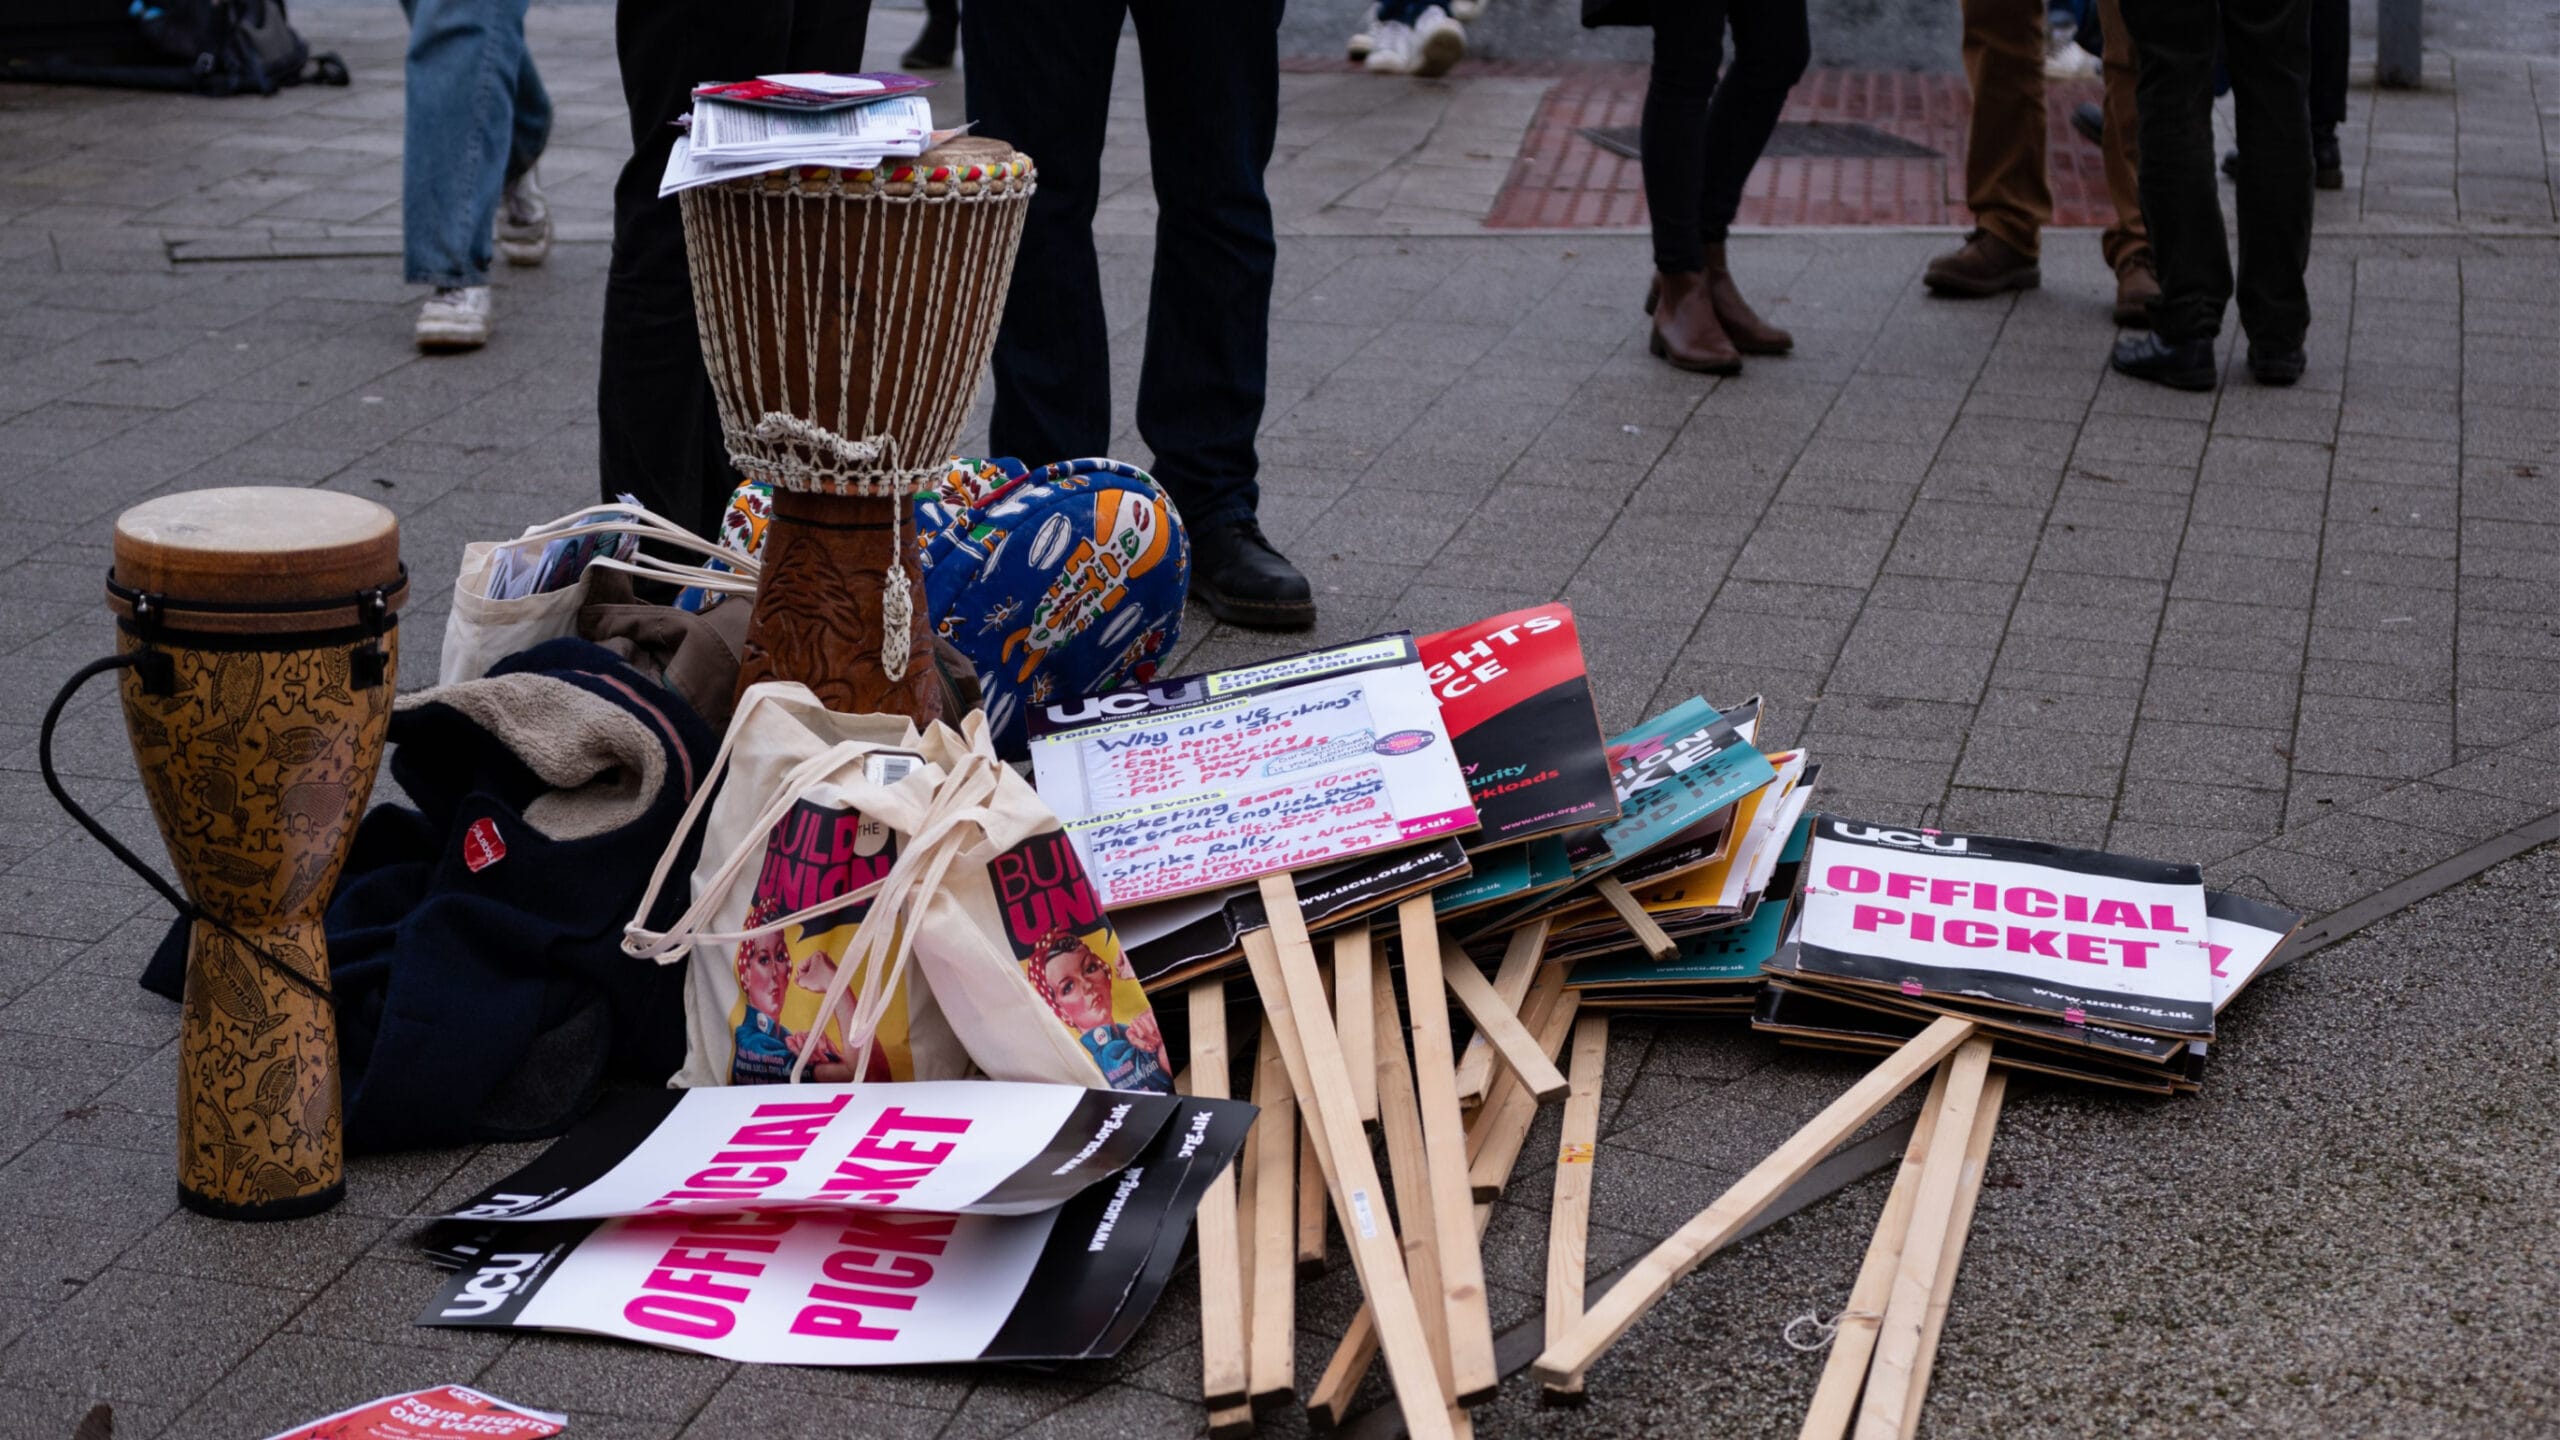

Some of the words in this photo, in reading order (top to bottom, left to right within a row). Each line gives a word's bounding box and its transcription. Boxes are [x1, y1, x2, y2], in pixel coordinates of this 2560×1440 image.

[1217, 661, 1299, 682] Trevor
[1308, 652, 1348, 664] the
[1426, 616, 1562, 685] GHTS
[1218, 651, 1395, 691] Strikeosaurus
[1442, 658, 1508, 698] CE
[1054, 722, 1129, 742] Today's
[1137, 698, 1247, 725] Campaigns
[1101, 711, 1148, 723] University
[1150, 706, 1167, 715] and
[1169, 700, 1204, 711] College
[1206, 694, 1233, 703] Union
[1097, 731, 1168, 752] Why
[1179, 719, 1225, 737] are
[1124, 741, 1241, 769] Equality
[1125, 745, 1173, 759] Fair
[1182, 720, 1293, 750] Pensions
[1127, 764, 1175, 778] Job
[1130, 770, 1182, 787] Fair
[1200, 736, 1329, 772] Workloads
[1098, 803, 1228, 838] Picketing
[1315, 768, 1378, 789] 10am
[1130, 779, 1184, 797] Fair
[1473, 768, 1560, 802] rkloads
[1064, 807, 1143, 828] Today's
[1151, 792, 1221, 810] Events
[1095, 835, 1138, 852] The
[1145, 817, 1220, 841] Great
[1227, 793, 1317, 824] English
[1401, 815, 1453, 838] rg.uk
[1500, 801, 1596, 831] www.ucu.org.uk
[995, 834, 1080, 903] BUI
[1105, 844, 1160, 862] 12pm
[1112, 854, 1194, 880] Strike
[1208, 835, 1275, 856] Rally
[756, 851, 892, 904] UNION
[1297, 850, 1445, 907] ww.ucu.org.uk
[1437, 882, 1501, 903] .ucu.org.uk
[1826, 865, 2189, 933] OFFICIAL
[1852, 904, 2159, 969] PICKET
[1656, 964, 1744, 974] www.ucu.org.uk
[2032, 987, 2194, 1020] www.ucu.org.uk
[2075, 1023, 2156, 1045] .org.uk
[644, 1094, 855, 1208] ICIAL
[1052, 1104, 1132, 1175] www.ucu.org.uk
[1178, 1111, 1213, 1158] org.uk
[1088, 1167, 1144, 1251] www.ucu.org.uk
[624, 1207, 800, 1340] OFFIC
[789, 1212, 960, 1341] PICK
[390, 1405, 437, 1427] ONE
[439, 1421, 516, 1435] VOICE
[403, 1397, 466, 1421] FOUR
[468, 1414, 554, 1434] FIGHTS
